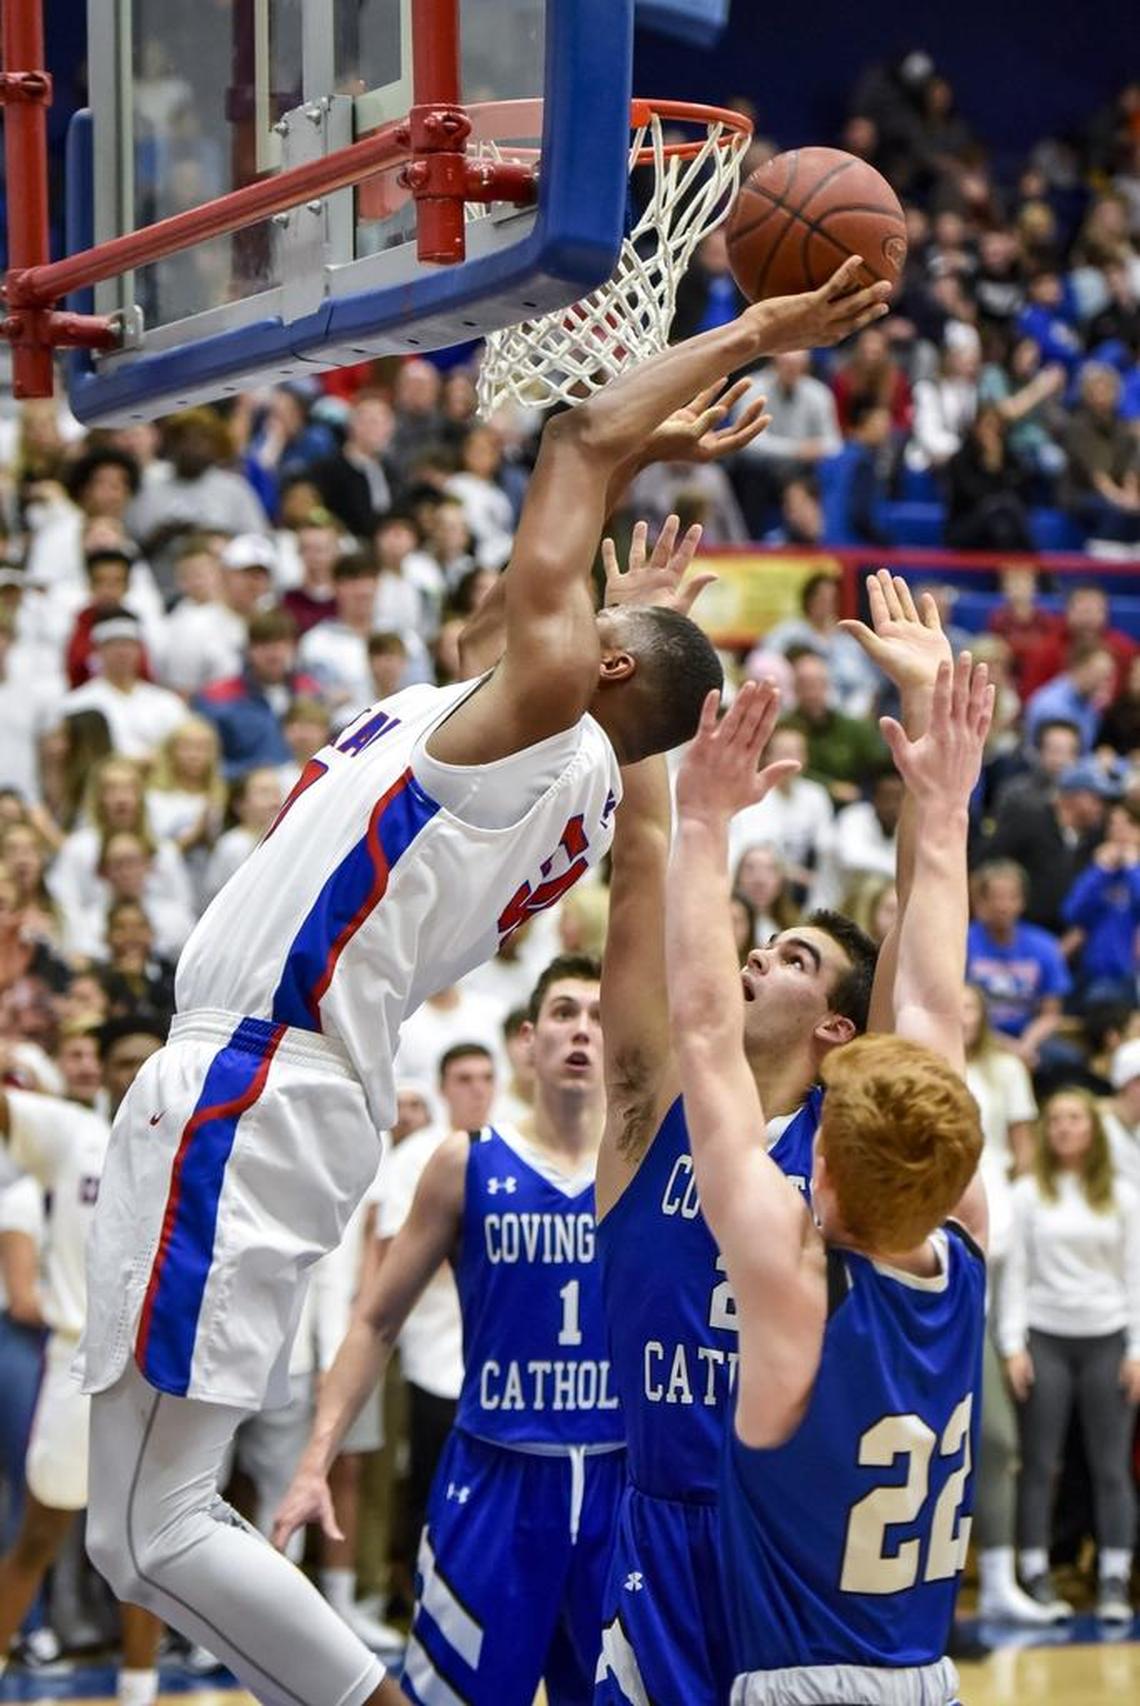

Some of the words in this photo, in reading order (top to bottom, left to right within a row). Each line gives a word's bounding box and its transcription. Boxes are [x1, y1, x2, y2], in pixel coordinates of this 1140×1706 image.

[484, 1212, 596, 1265] COVING
[557, 1279, 583, 1346] 1
[480, 1359, 620, 1411] CATHOL
[838, 1391, 974, 1595] 22
